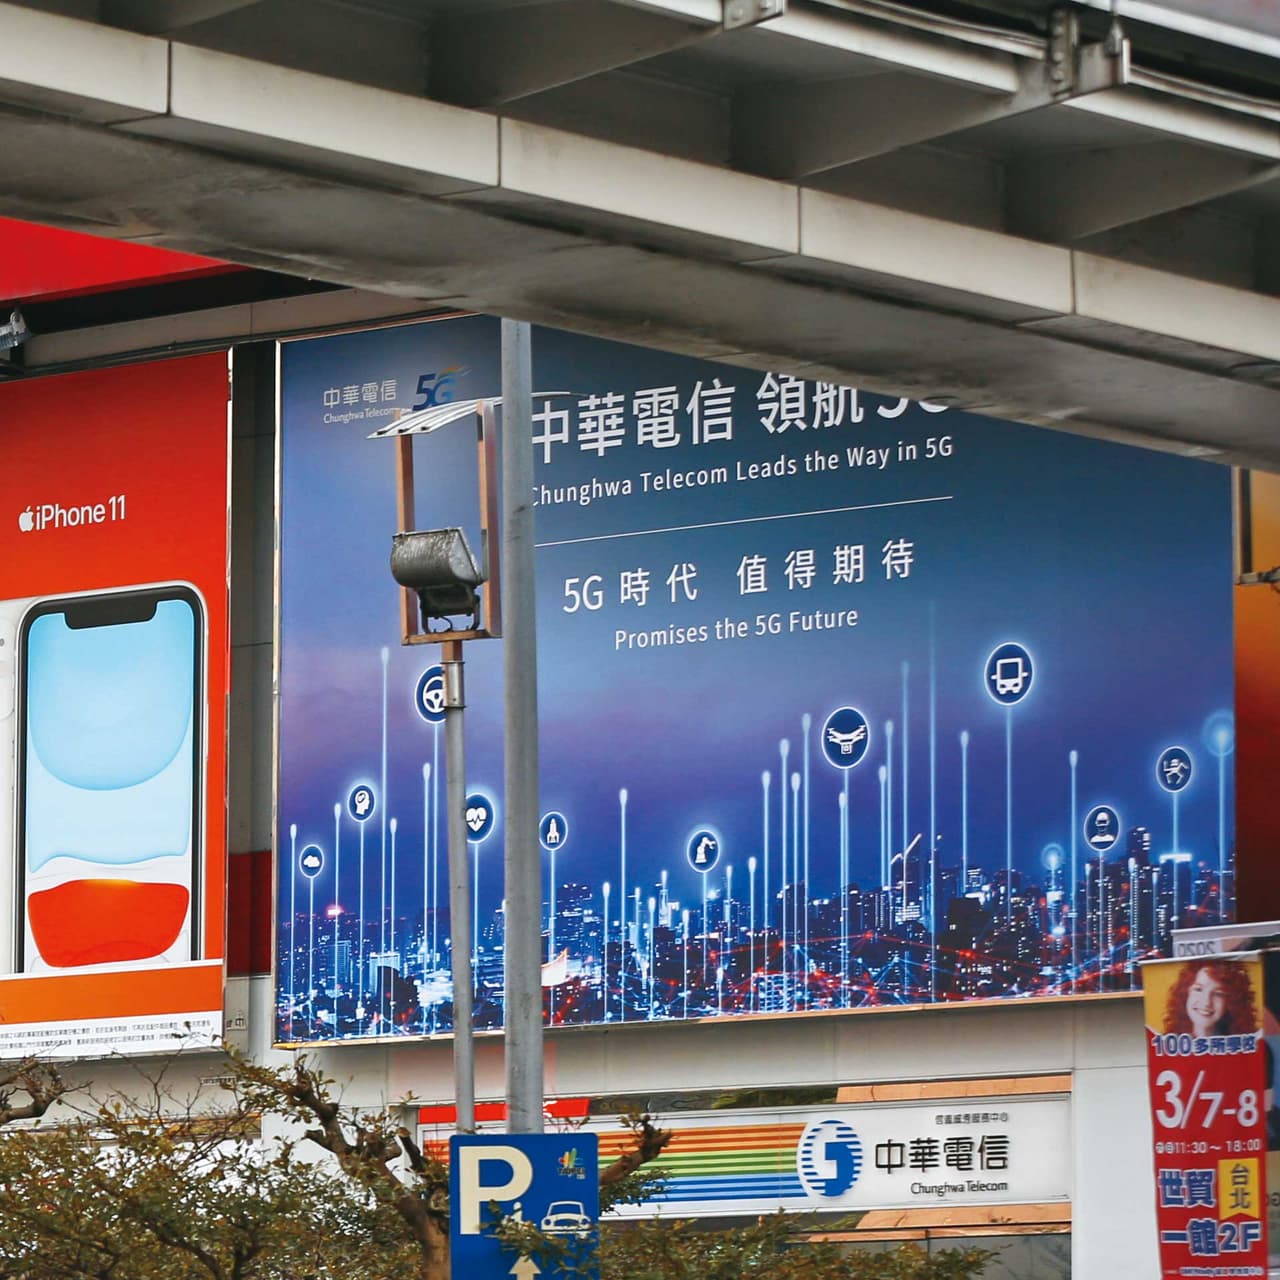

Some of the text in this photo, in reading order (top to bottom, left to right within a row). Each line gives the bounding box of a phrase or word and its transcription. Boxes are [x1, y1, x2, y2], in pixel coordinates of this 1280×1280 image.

[323, 379, 398, 408] 中華電信
[323, 409, 364, 425] Chunghwa
[532, 371, 865, 465] 中華電信 領航
[640, 464, 729, 493] Telecom
[736, 455, 798, 481] Leads
[805, 449, 840, 473] the
[847, 444, 891, 471] Way
[897, 441, 918, 463] in
[925, 435, 953, 460] 5G
[35, 494, 126, 531] iPhone 11
[614, 607, 859, 651] Promises the 5G Future
[1156, 1069, 1259, 1130] 3/7-8
[874, 1134, 1011, 1175] 中華電信
[458, 1145, 534, 1235] P
[910, 1180, 1009, 1197] Chunghwa Telecom
[1158, 1168, 1216, 1209] 世貿
[1229, 1163, 1251, 1209] 台北
